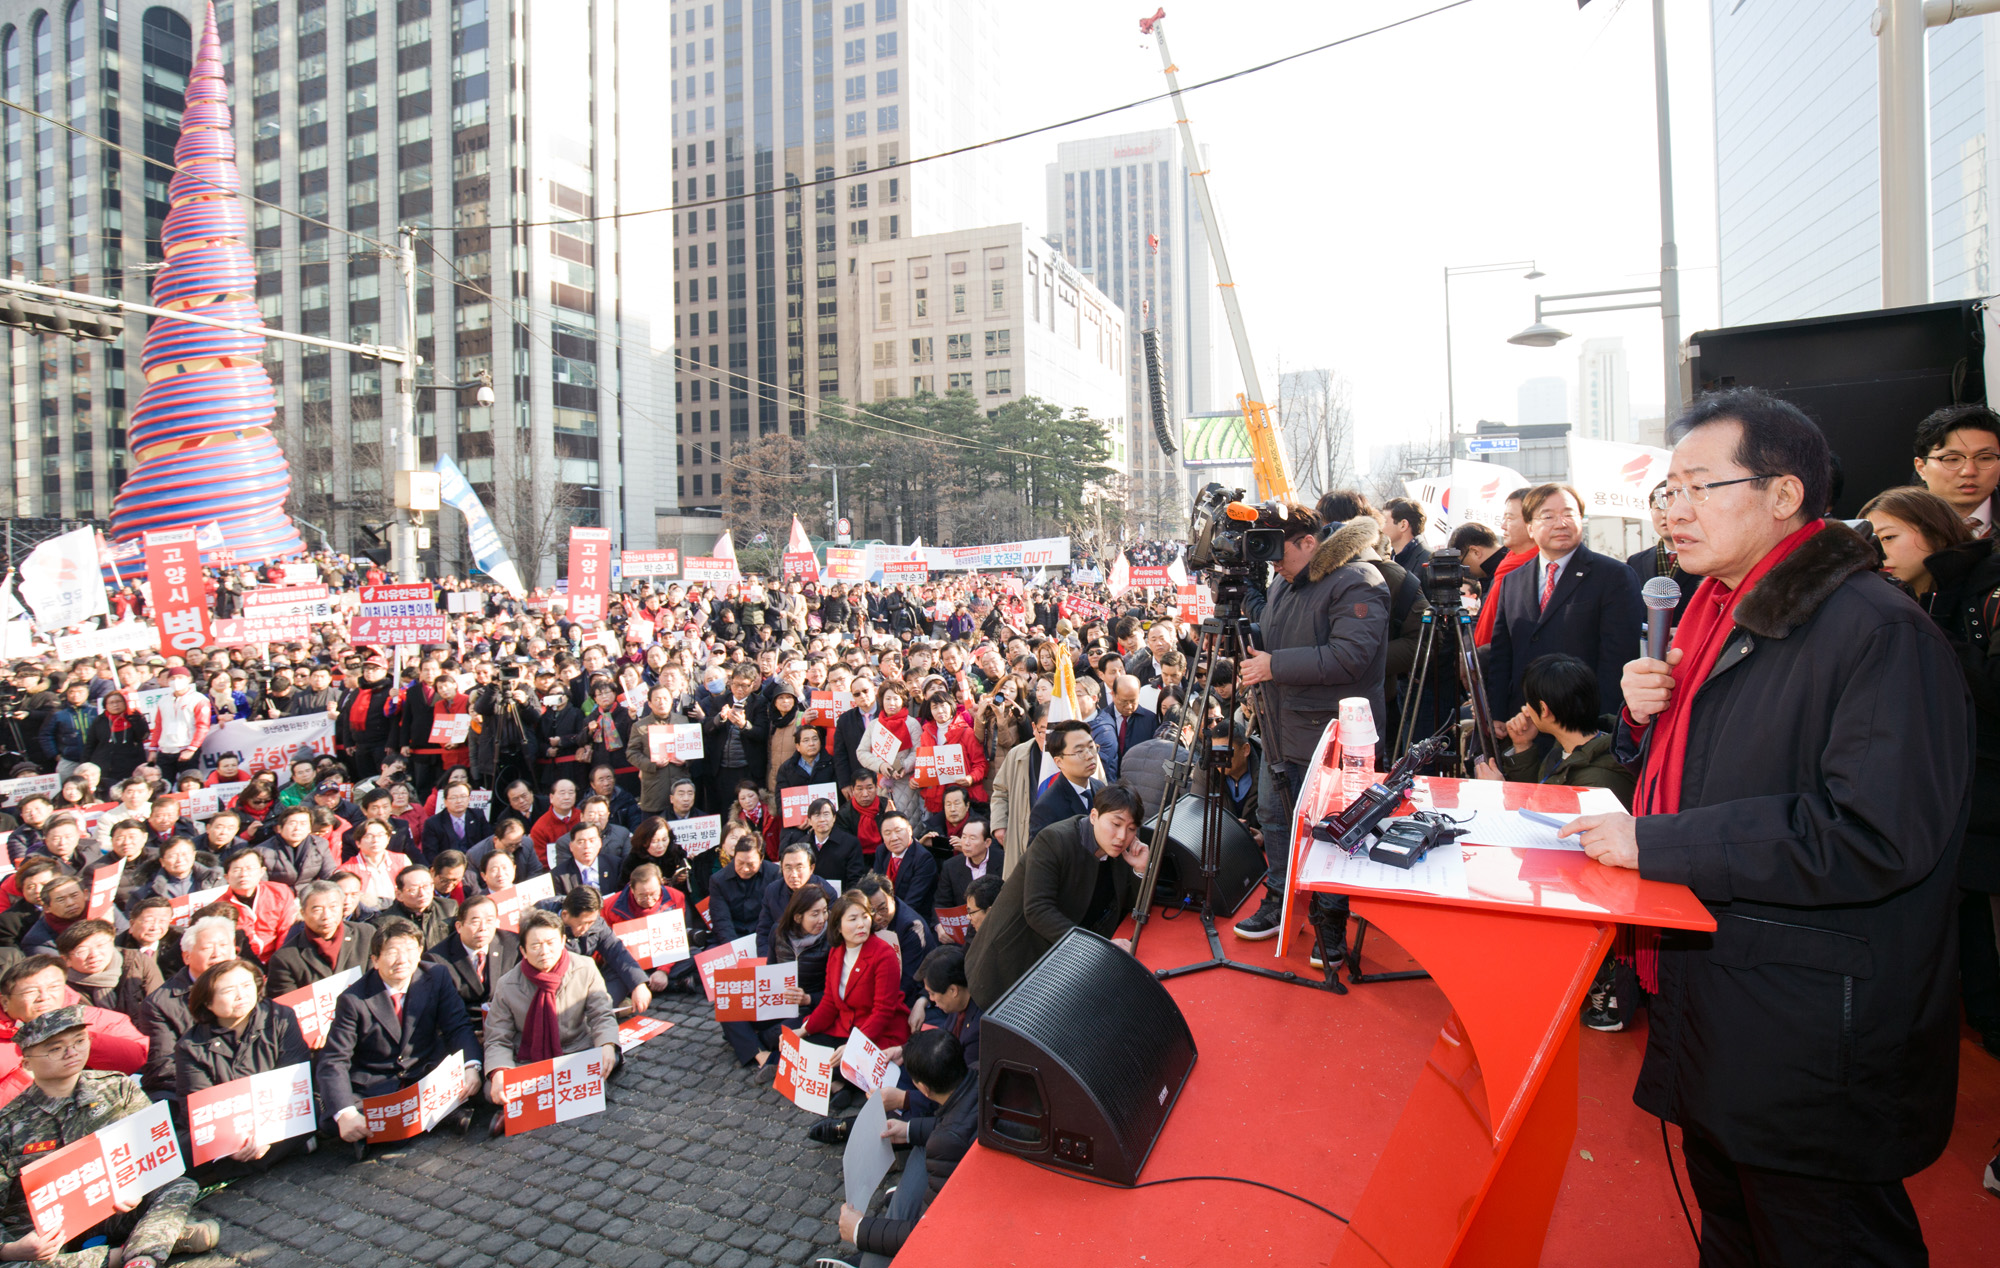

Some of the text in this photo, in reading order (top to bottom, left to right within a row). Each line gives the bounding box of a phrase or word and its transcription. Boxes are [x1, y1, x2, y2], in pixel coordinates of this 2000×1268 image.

[1259, 408, 1268, 428] KATO
[785, 560, 814, 573] 분당갑
[1023, 550, 1053, 564] OUT!
[377, 587, 430, 600] 자유한국당
[162, 606, 206, 651] 병
[378, 618, 400, 628] 부산
[378, 629, 443, 643] 당원협의회
[936, 754, 963, 765] 친 북
[938, 765, 964, 776] 文정권
[700, 829, 717, 840] 방문
[652, 921, 684, 939] 친 북
[653, 935, 686, 953] 文정권
[702, 952, 738, 974] 김영철
[715, 979, 755, 994] 김영철
[758, 979, 771, 992] 친
[716, 995, 755, 1010] 방 한
[758, 993, 794, 1008] 文정
[557, 1061, 601, 1086] 친 북
[778, 1061, 787, 1077] 방
[798, 1055, 830, 1080] 친 북
[257, 1078, 309, 1106] 친 북
[422, 1084, 436, 1102] 친
[505, 1073, 553, 1099] 김영철
[558, 1079, 602, 1105] 文정권
[797, 1074, 828, 1098] 文정권
[192, 1092, 252, 1126] 김영철
[366, 1095, 419, 1119] 김영철
[424, 1079, 465, 1117] 文정권
[506, 1092, 553, 1118] 방 한
[260, 1099, 311, 1126] 文정권
[368, 1110, 420, 1132] 방 한
[110, 1120, 171, 1168] 친 북
[194, 1124, 216, 1146] 방
[115, 1140, 177, 1189] 문재인
[30, 1156, 106, 1211] 김영철
[37, 1178, 111, 1232] 방 한
